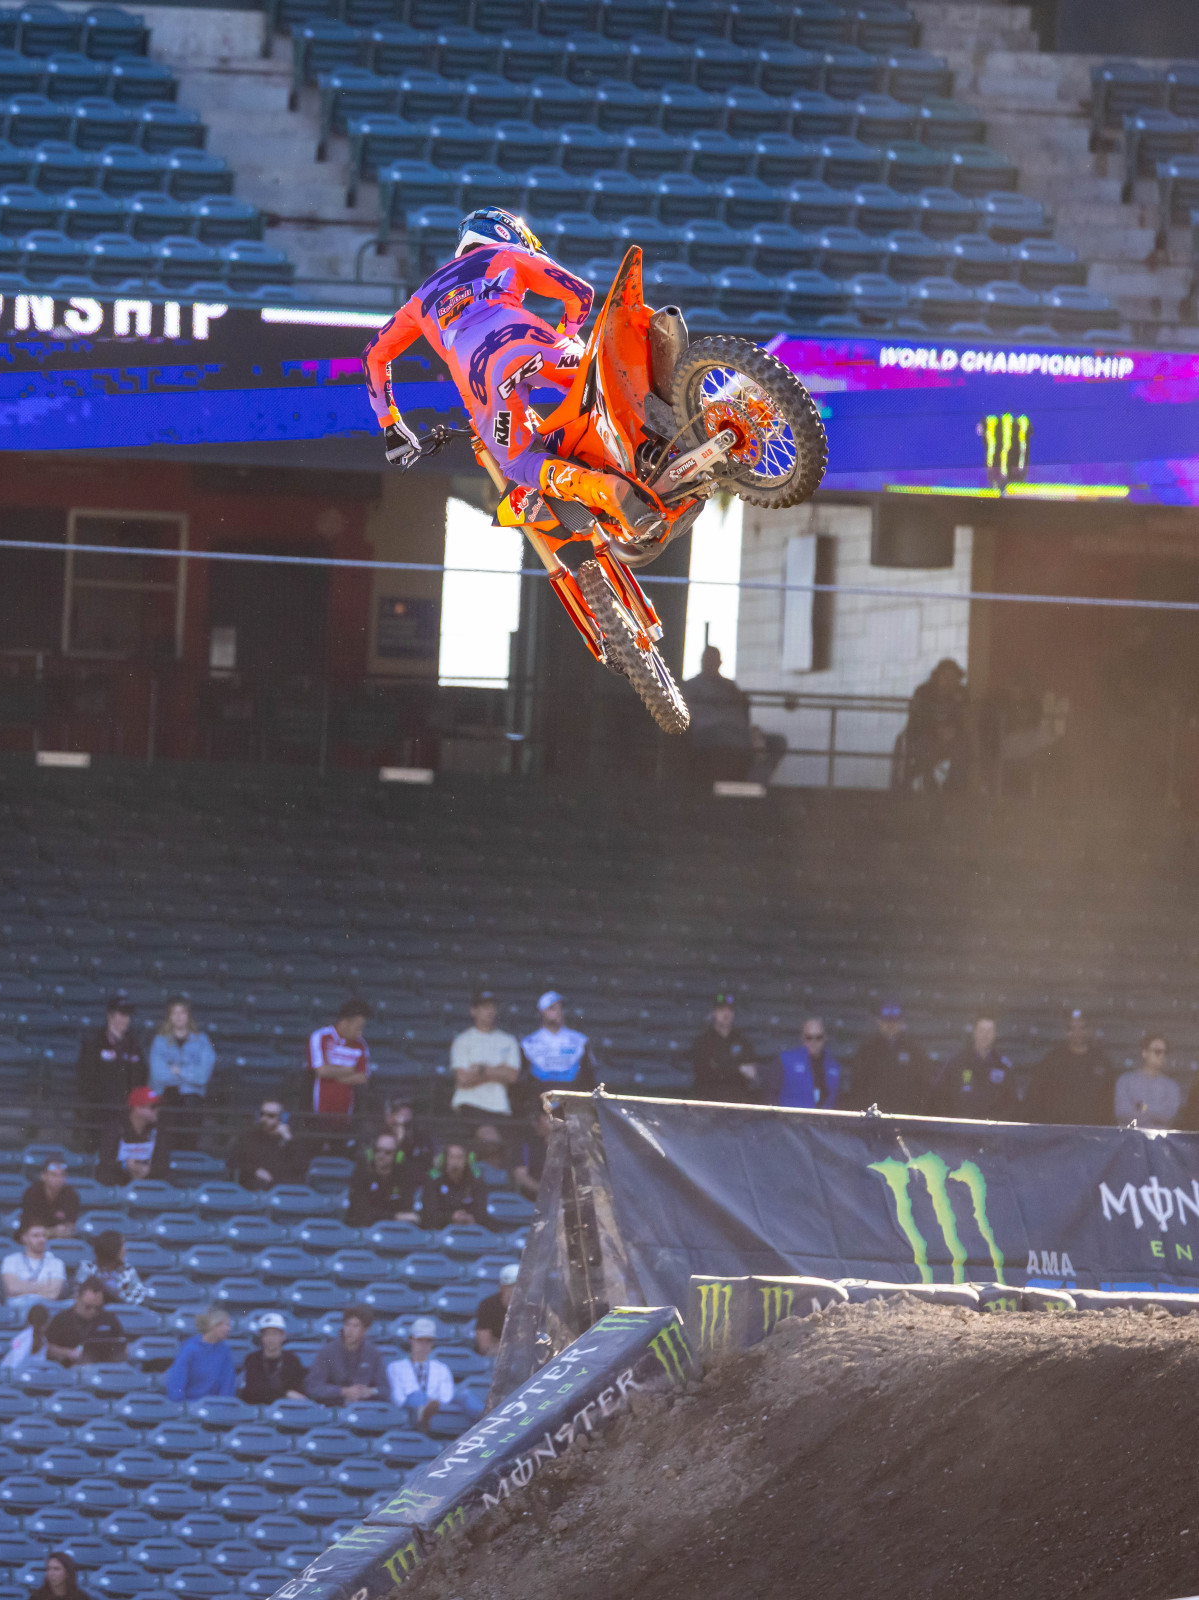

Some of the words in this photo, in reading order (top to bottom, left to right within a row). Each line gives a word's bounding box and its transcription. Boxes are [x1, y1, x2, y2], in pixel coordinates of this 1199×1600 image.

[496, 226, 509, 239] BELL
[453, 289, 471, 304] Bull
[497, 351, 544, 400] ET3
[880, 347, 958, 372] WORLD
[959, 350, 1134, 378] CHAMPIONSHIP
[494, 411, 511, 447] KTM
[1026, 1250, 1077, 1277] AMA
[427, 1345, 599, 1479] MONSTER
[480, 1367, 589, 1458] ENERGY
[481, 1368, 645, 1510] MONSTER
